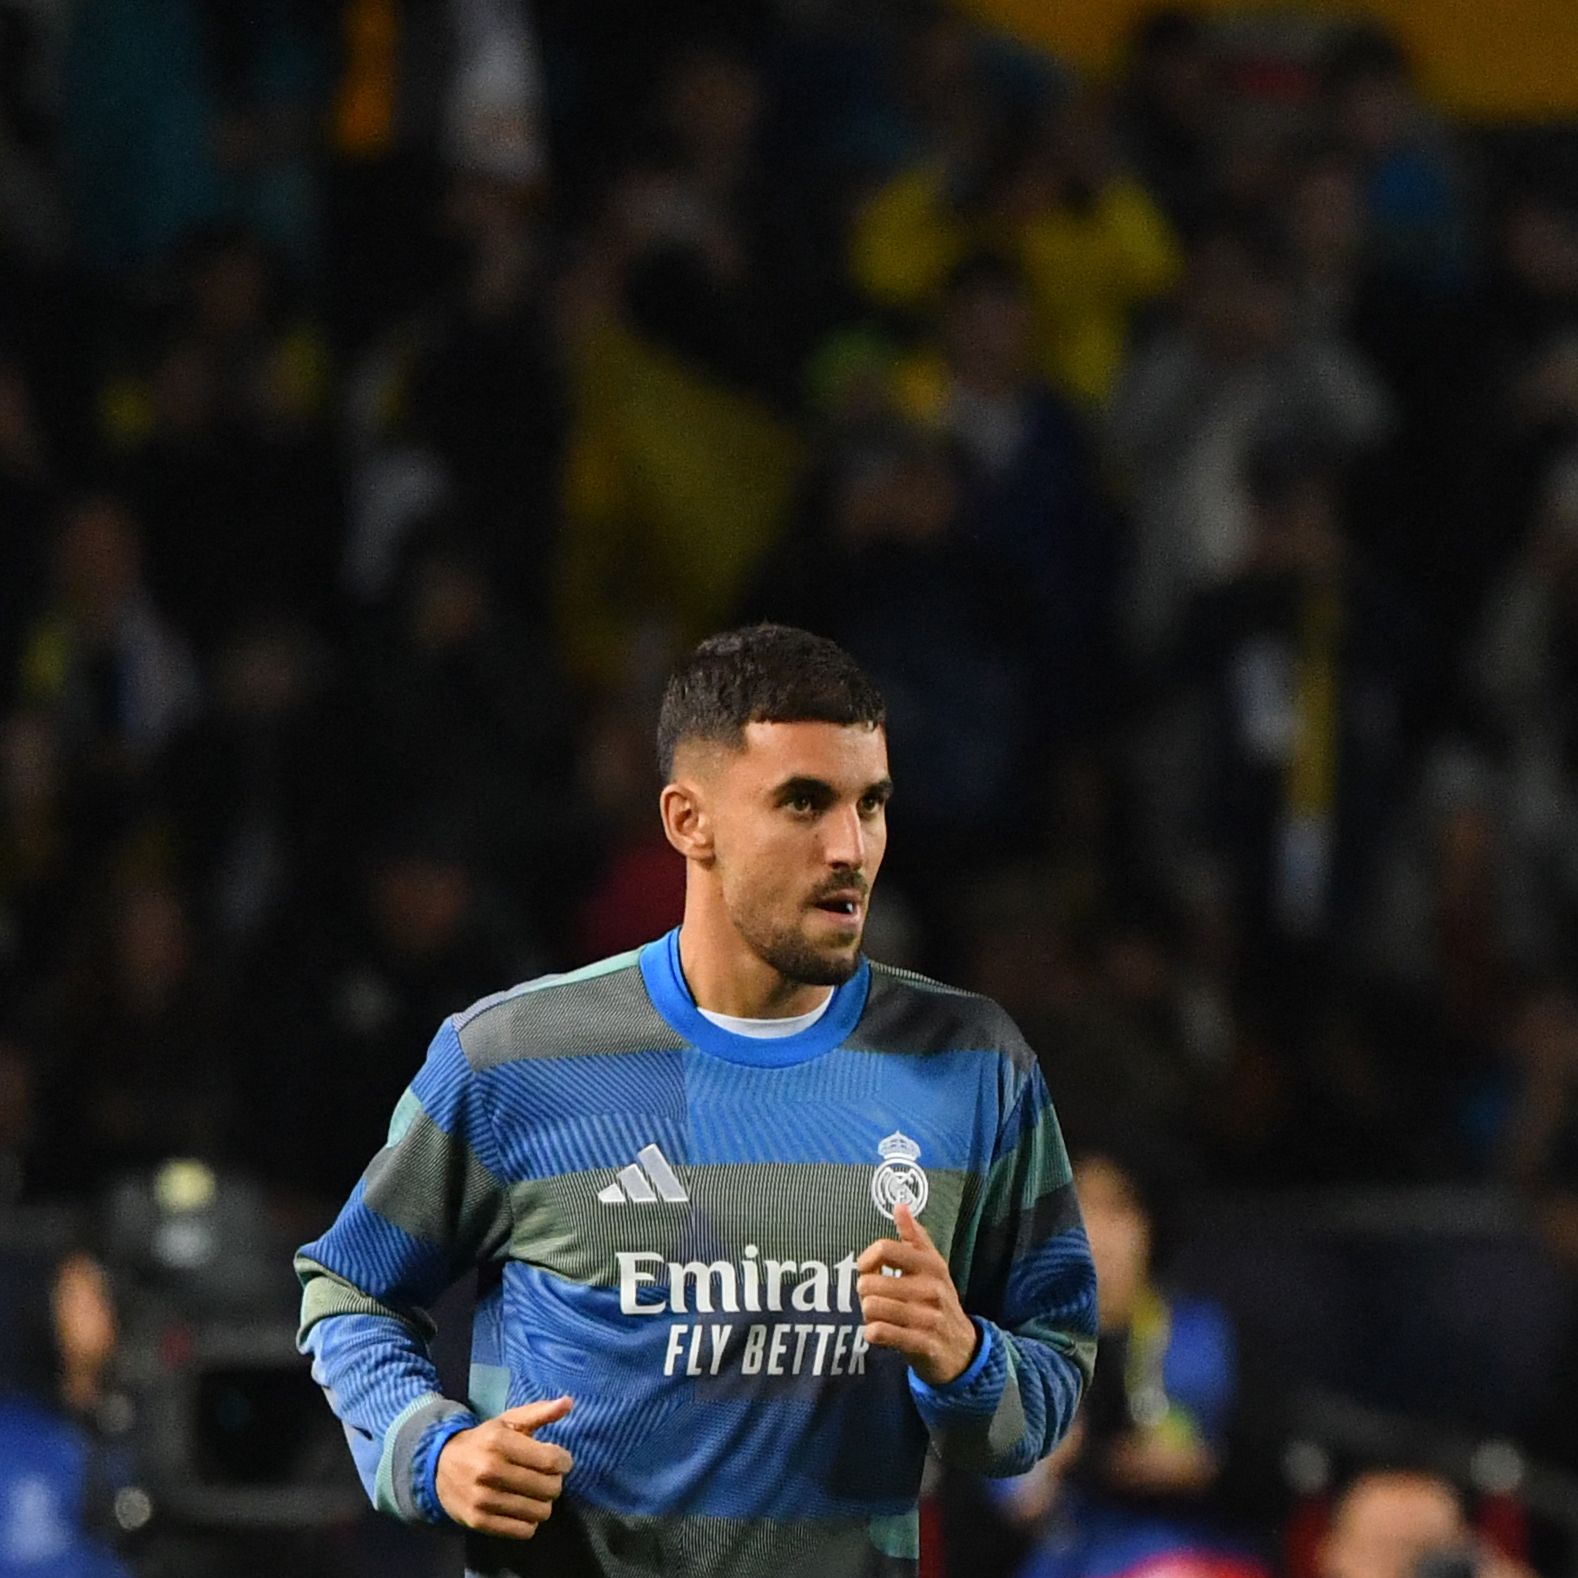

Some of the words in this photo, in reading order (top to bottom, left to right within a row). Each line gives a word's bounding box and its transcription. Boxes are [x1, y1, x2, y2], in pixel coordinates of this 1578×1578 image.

[615, 1245, 903, 1315] Emirat
[664, 1324, 731, 1376] FLY
[741, 1324, 871, 1376] BETTER
